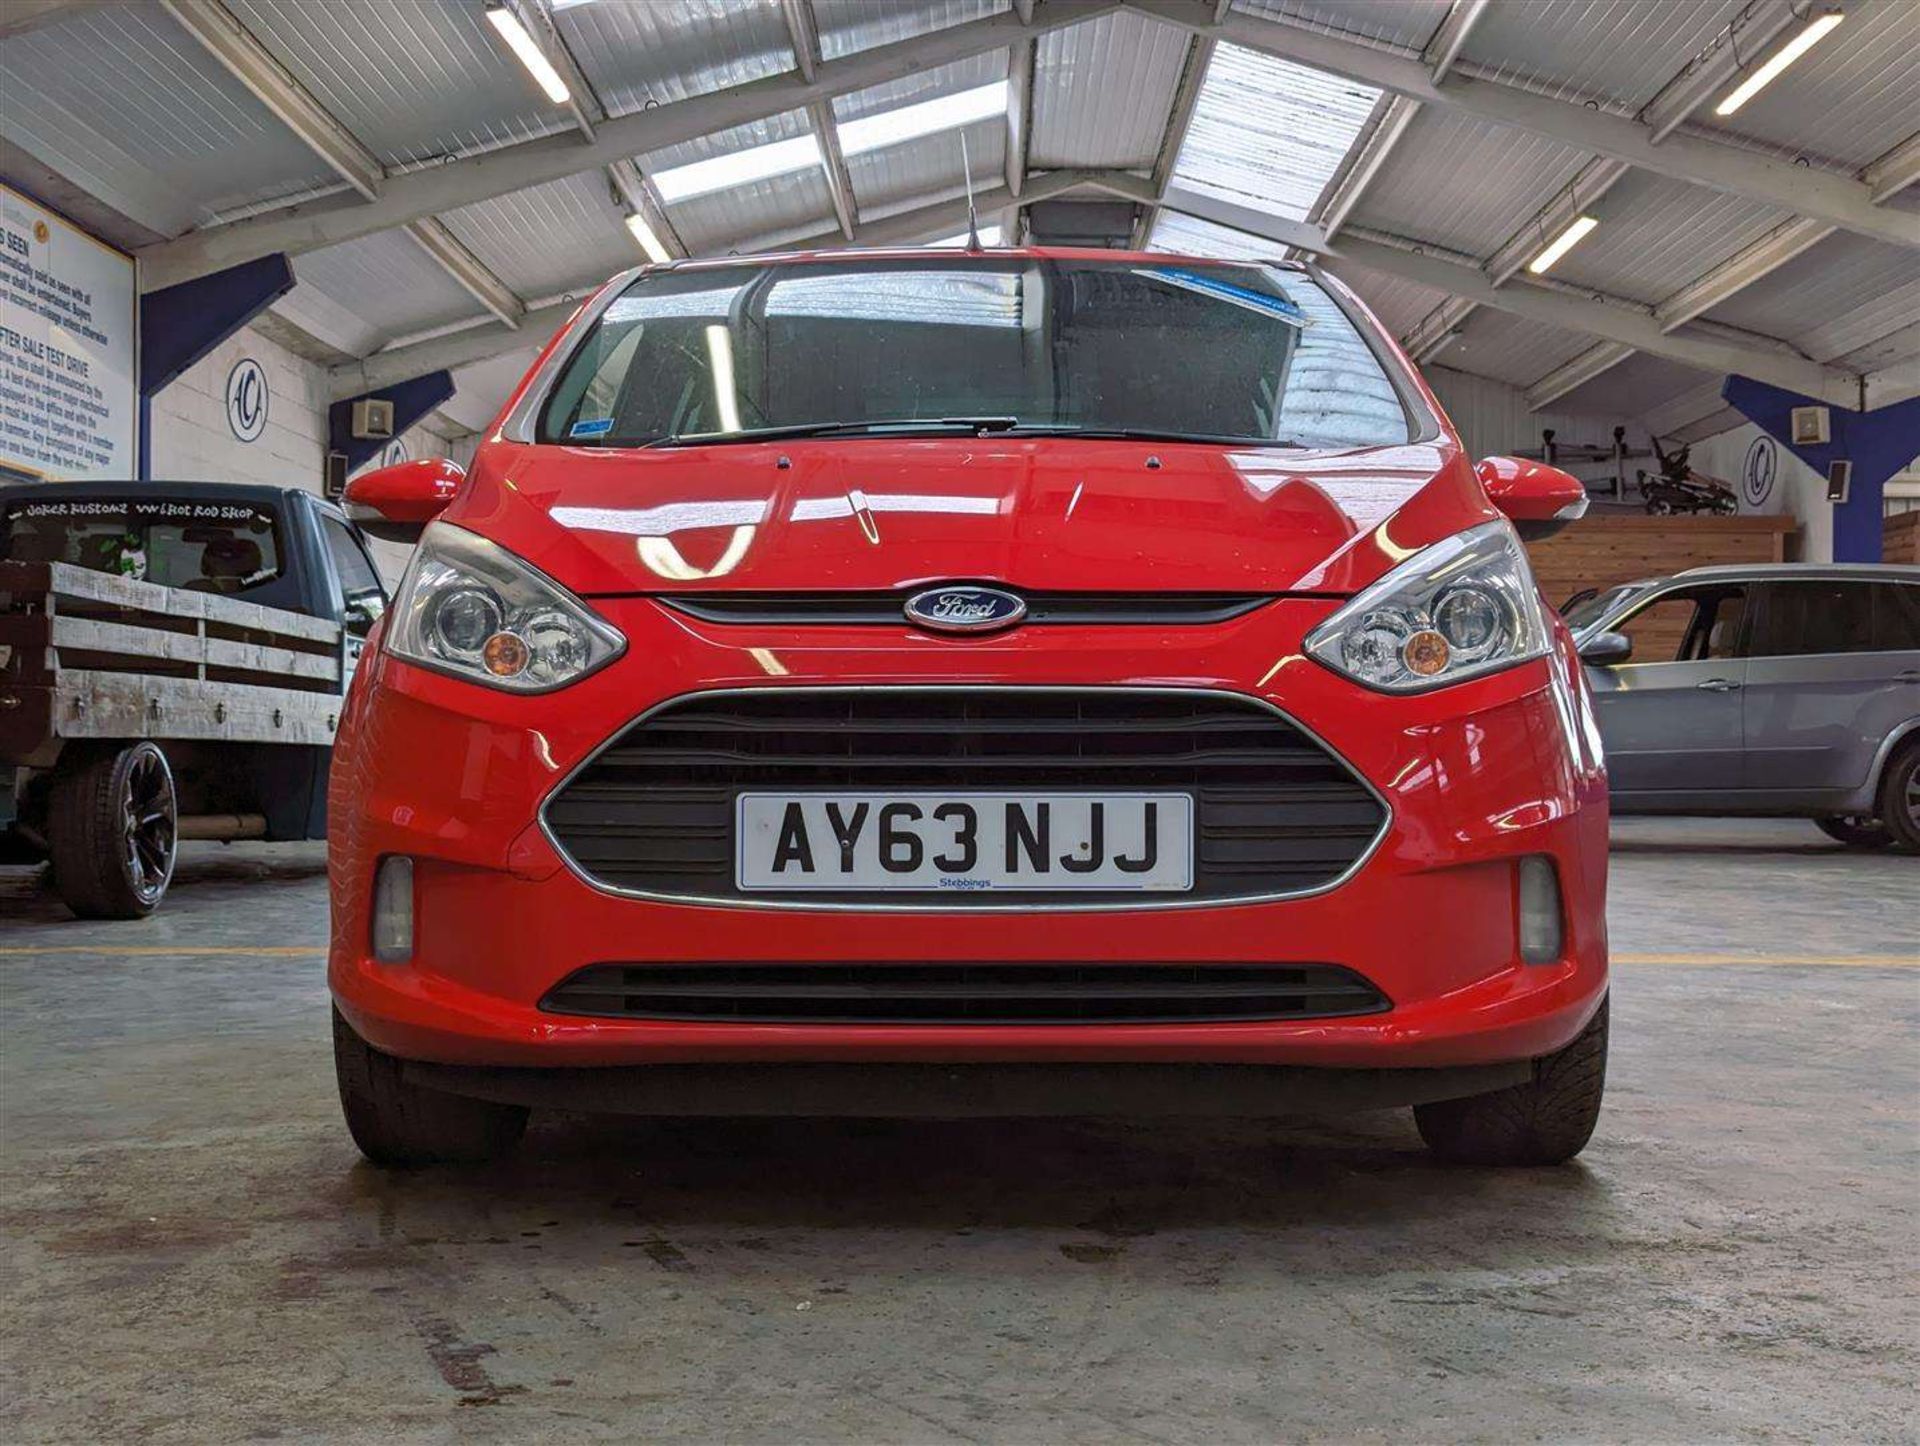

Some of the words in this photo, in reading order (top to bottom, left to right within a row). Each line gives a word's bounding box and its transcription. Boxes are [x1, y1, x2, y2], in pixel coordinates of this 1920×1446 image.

[8, 231, 29, 257] SEEN
[23, 336, 44, 359] SALE
[46, 345, 65, 367] TEST
[67, 354, 89, 378] DRIVE
[194, 505, 219, 518] ROD
[221, 506, 254, 519] SHOP
[932, 592, 997, 618] Ford
[771, 802, 978, 873] AY63
[1004, 802, 1158, 873] NJJ
